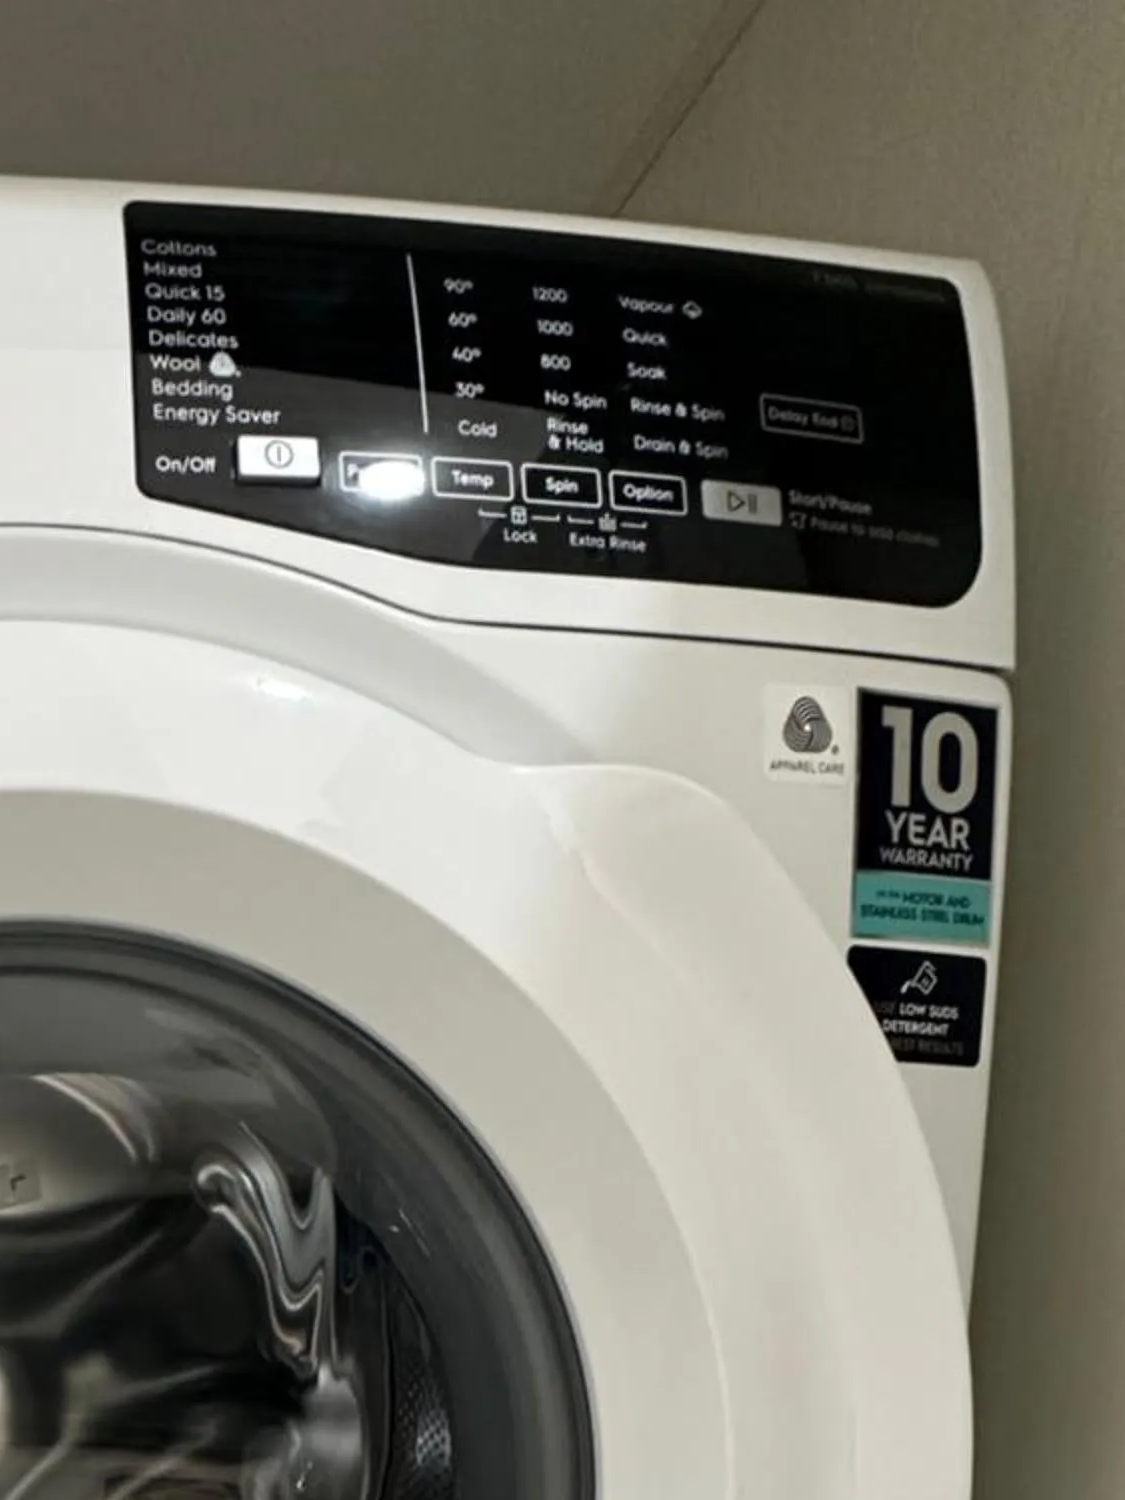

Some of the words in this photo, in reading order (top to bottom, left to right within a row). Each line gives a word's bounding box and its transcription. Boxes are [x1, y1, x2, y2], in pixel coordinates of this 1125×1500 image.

[140, 238, 217, 258] Cottons
[143, 261, 203, 279] Mixed
[144, 281, 201, 301] Quick
[205, 285, 225, 302] 15
[532, 286, 569, 304] 1200
[618, 294, 674, 317] Vapour
[147, 305, 196, 327] Daily
[200, 307, 226, 326] 60
[536, 319, 574, 337] 1000
[622, 327, 668, 347] Quick
[148, 328, 239, 350] Delicates
[149, 354, 202, 373] Wool
[540, 353, 572, 371] 800
[627, 361, 667, 381] Soak
[151, 378, 233, 402] Bedding
[544, 389, 569, 408] No
[572, 392, 608, 413] Spin
[630, 397, 672, 418] Rinse
[674, 402, 688, 418] &
[691, 401, 726, 423] Spin
[152, 402, 220, 427] Energy
[225, 404, 281, 425] Saver
[457, 419, 498, 439] Cold
[546, 416, 589, 436] Rinse
[548, 436, 563, 451] &
[565, 435, 605, 454] Hold
[633, 434, 675, 454] Drain
[678, 439, 691, 456] &
[695, 440, 729, 460] Spin
[155, 455, 216, 474] On/Off
[451, 469, 495, 490] Temp
[544, 476, 579, 495] Spin
[622, 482, 674, 503] Option
[503, 528, 538, 544] Lock
[569, 532, 606, 550] Extra
[609, 535, 648, 553] Rinse
[770, 759, 817, 776] APPAREL
[818, 760, 845, 777] CARE
[881, 704, 980, 814] 10
[885, 809, 970, 852] YEAR
[879, 846, 974, 873] WARRANTY
[902, 892, 944, 906] MOTOR
[946, 895, 972, 910] AND
[898, 1001, 928, 1018] LOW
[928, 1004, 960, 1021] SUDS
[882, 1018, 950, 1037] DETERGENT
